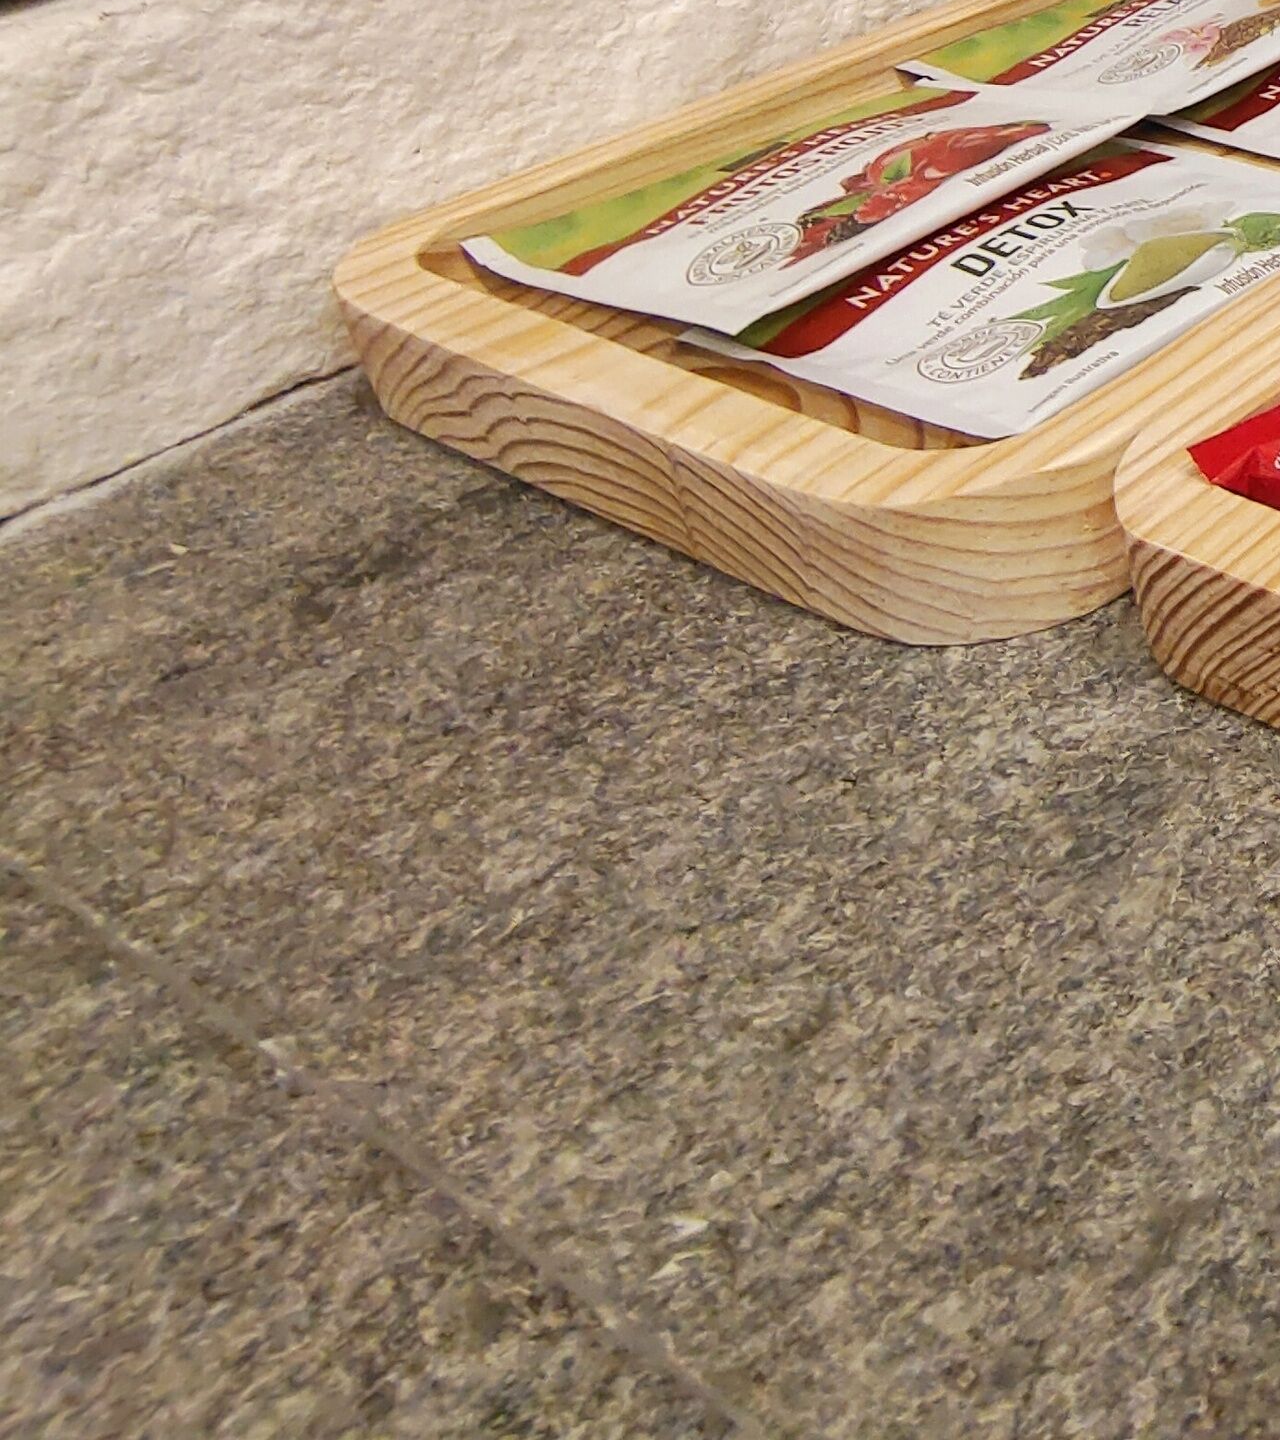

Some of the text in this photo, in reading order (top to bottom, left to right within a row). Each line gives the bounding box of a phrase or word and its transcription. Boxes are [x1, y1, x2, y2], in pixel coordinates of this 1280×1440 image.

[688, 157, 818, 226] FRUTOS
[845, 211, 1001, 310] NATURE'S
[950, 200, 1096, 278] DETOX
[954, 268, 1031, 324] combinación
[1028, 248, 1057, 269] para
